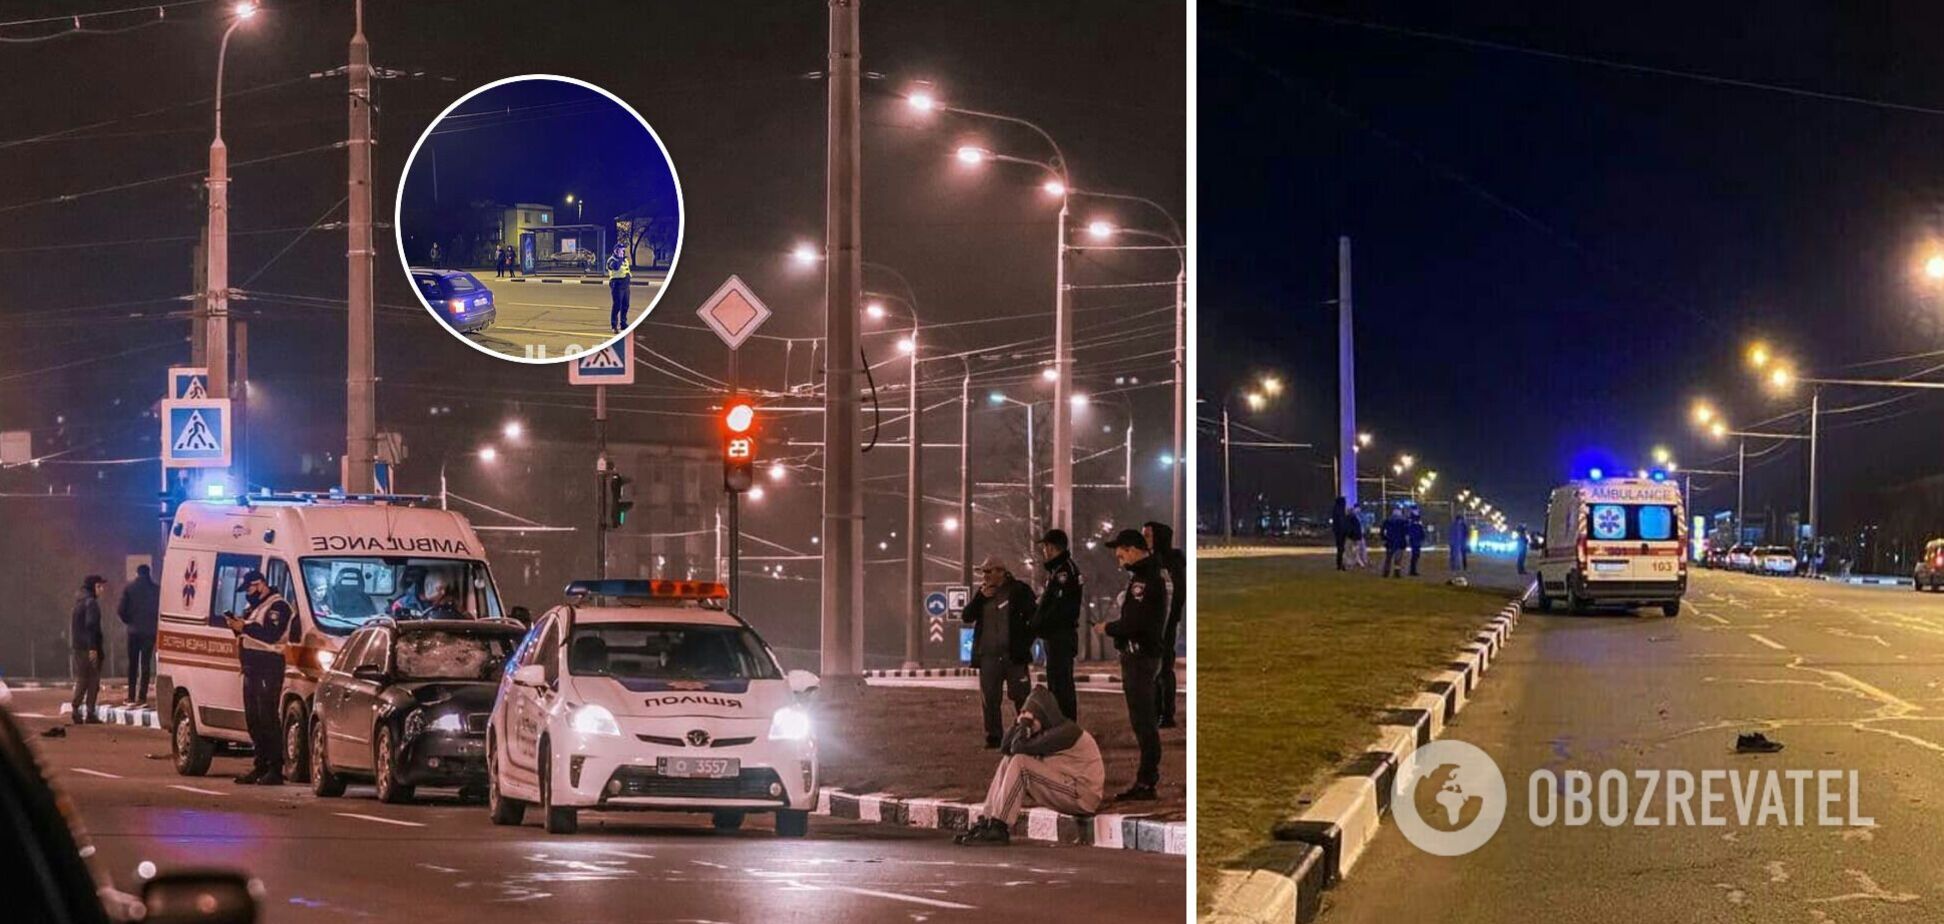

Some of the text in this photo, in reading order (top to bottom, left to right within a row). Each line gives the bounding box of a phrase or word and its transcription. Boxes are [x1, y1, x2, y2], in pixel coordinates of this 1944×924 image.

[1591, 486, 1671, 501] AMBULANCE
[1652, 561, 1673, 572] 103
[644, 695, 743, 708] ПОЛІЦІЯ
[695, 759, 729, 774] 3557
